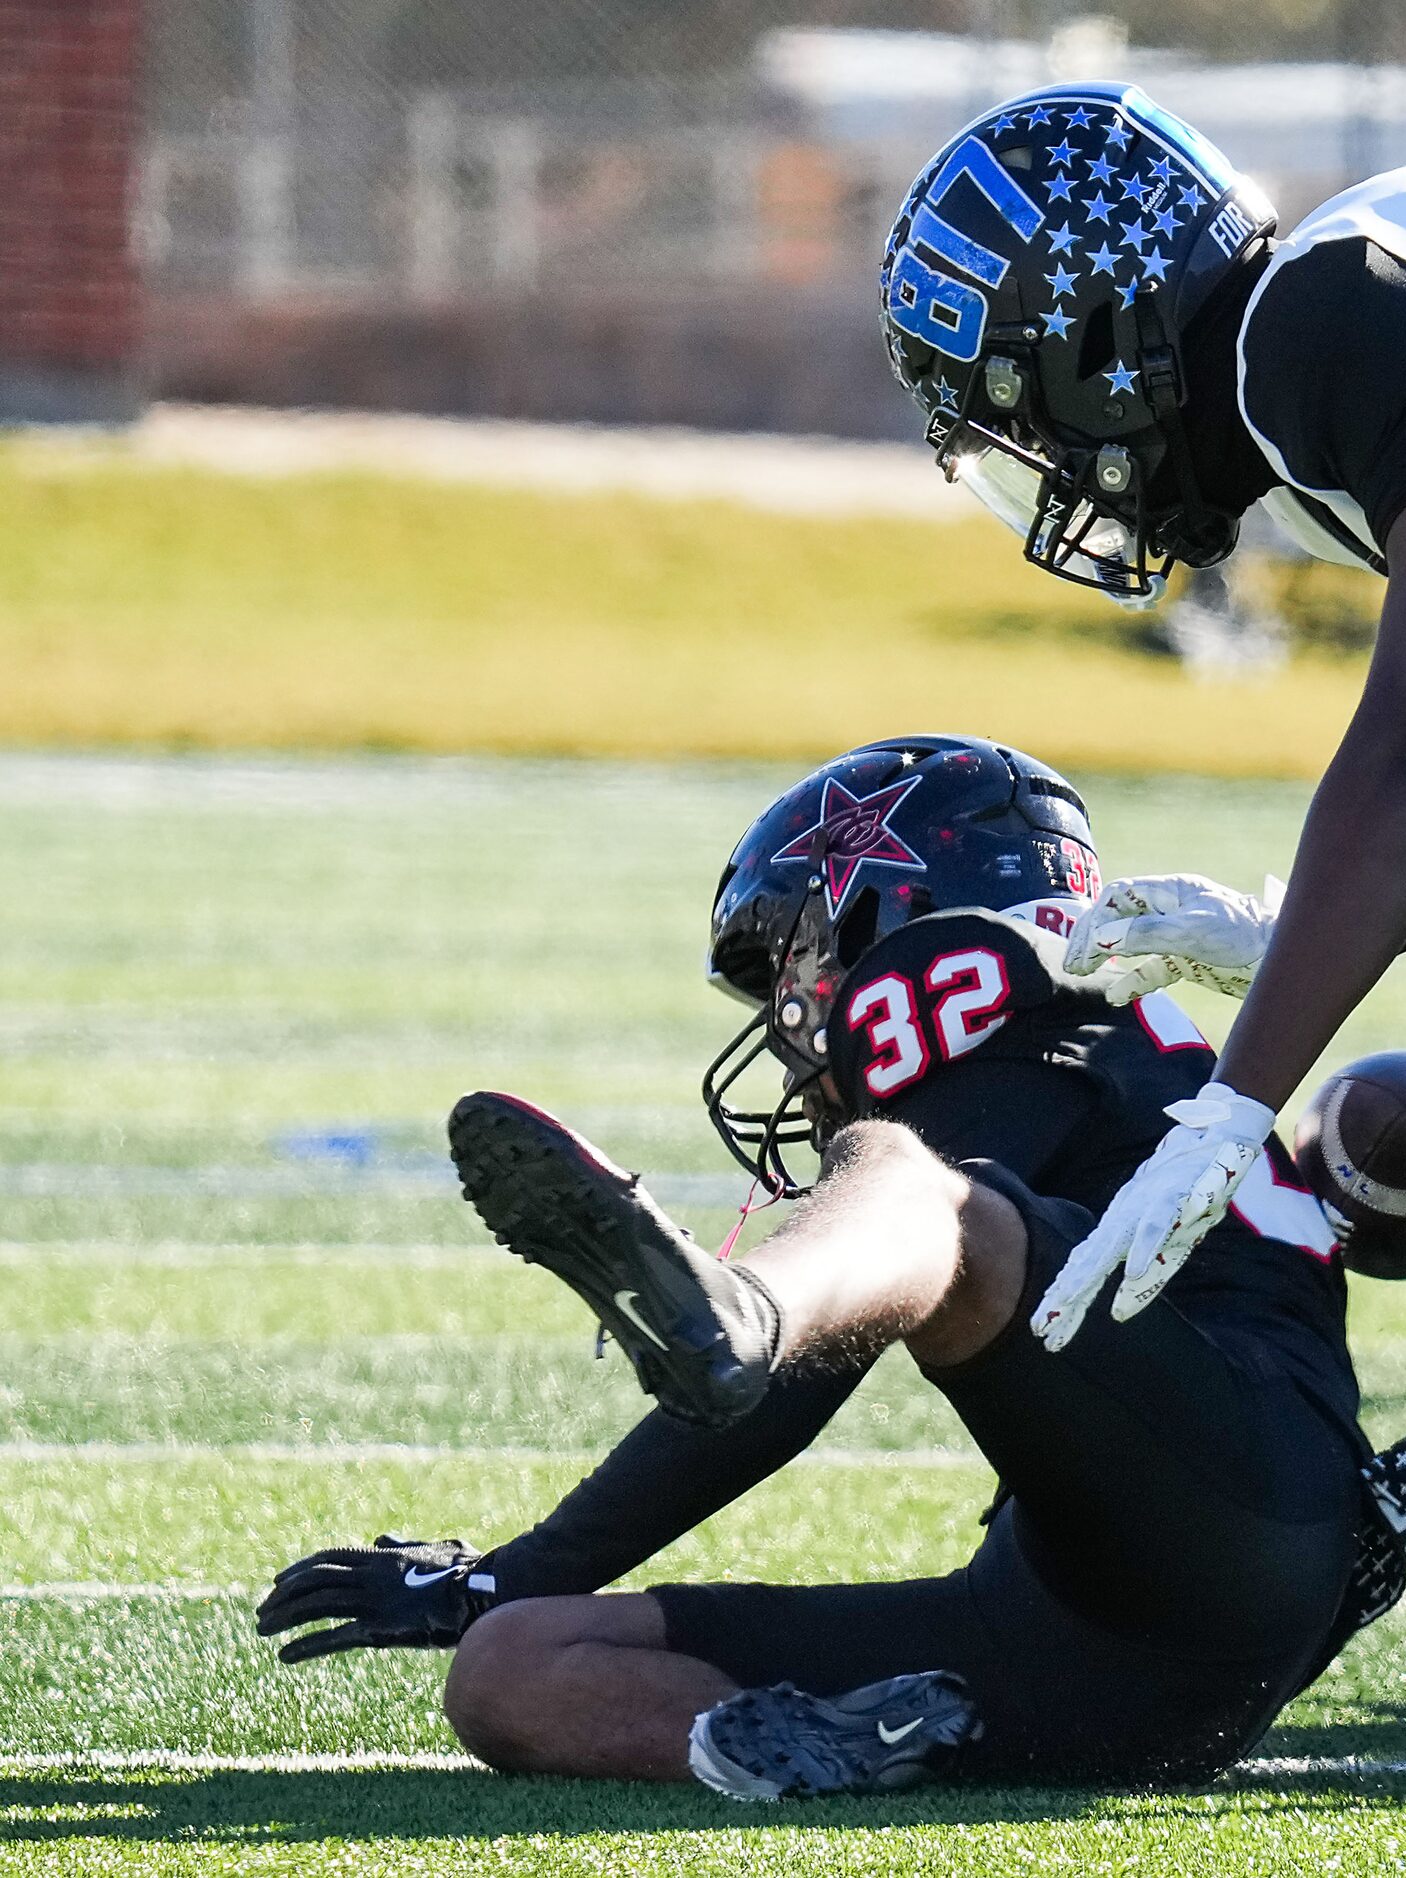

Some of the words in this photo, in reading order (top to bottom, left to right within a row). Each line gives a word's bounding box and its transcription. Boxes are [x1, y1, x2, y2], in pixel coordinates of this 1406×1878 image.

[889, 135, 1046, 363] 817
[1140, 182, 1167, 214] Riddell
[845, 945, 1014, 1098] 32
